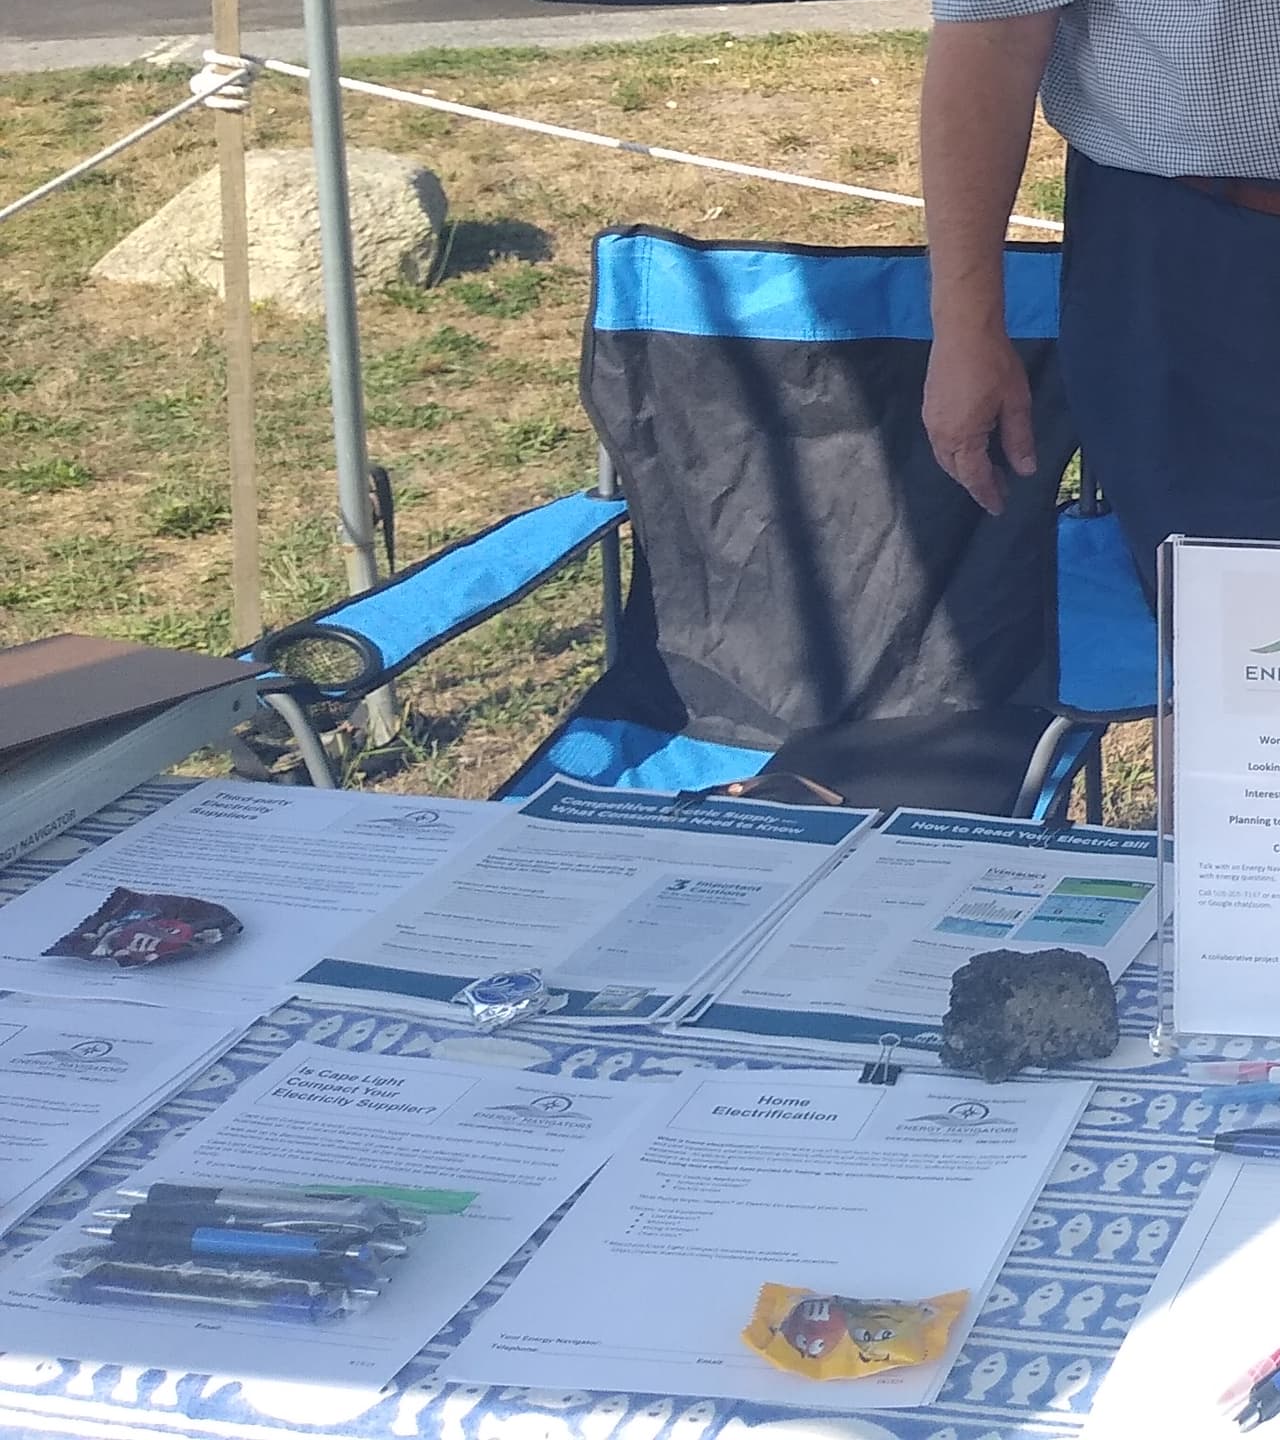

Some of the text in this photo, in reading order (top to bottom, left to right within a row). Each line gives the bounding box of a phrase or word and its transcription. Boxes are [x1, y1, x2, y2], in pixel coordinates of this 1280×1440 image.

[214, 792, 294, 806] Third-party
[189, 807, 258, 820] Suppliers
[200, 800, 274, 815] Electricity
[559, 795, 661, 813] Competitive
[724, 810, 781, 824] Supply
[551, 803, 593, 818] What
[690, 816, 733, 828] Need
[736, 818, 755, 830] to
[756, 821, 805, 835] Know
[1229, 815, 1271, 827] Planning
[910, 820, 951, 834] How
[952, 824, 969, 835] to
[972, 827, 1014, 839] Read
[1057, 835, 1119, 848] Electric
[1122, 839, 1150, 850] Bill
[666, 879, 695, 892] 3
[298, 1065, 406, 1089] Is Cape Light
[285, 1076, 401, 1100] Compact Your
[271, 1087, 437, 1116] Electricity Supplier?
[757, 1094, 811, 1108] Home
[711, 1105, 839, 1124] Electrification
[521, 1117, 593, 1129] NAVIGATORS
[523, 1335, 554, 1346] Energy
[556, 1338, 600, 1347] Navigator
[490, 1343, 538, 1354] Telephone
